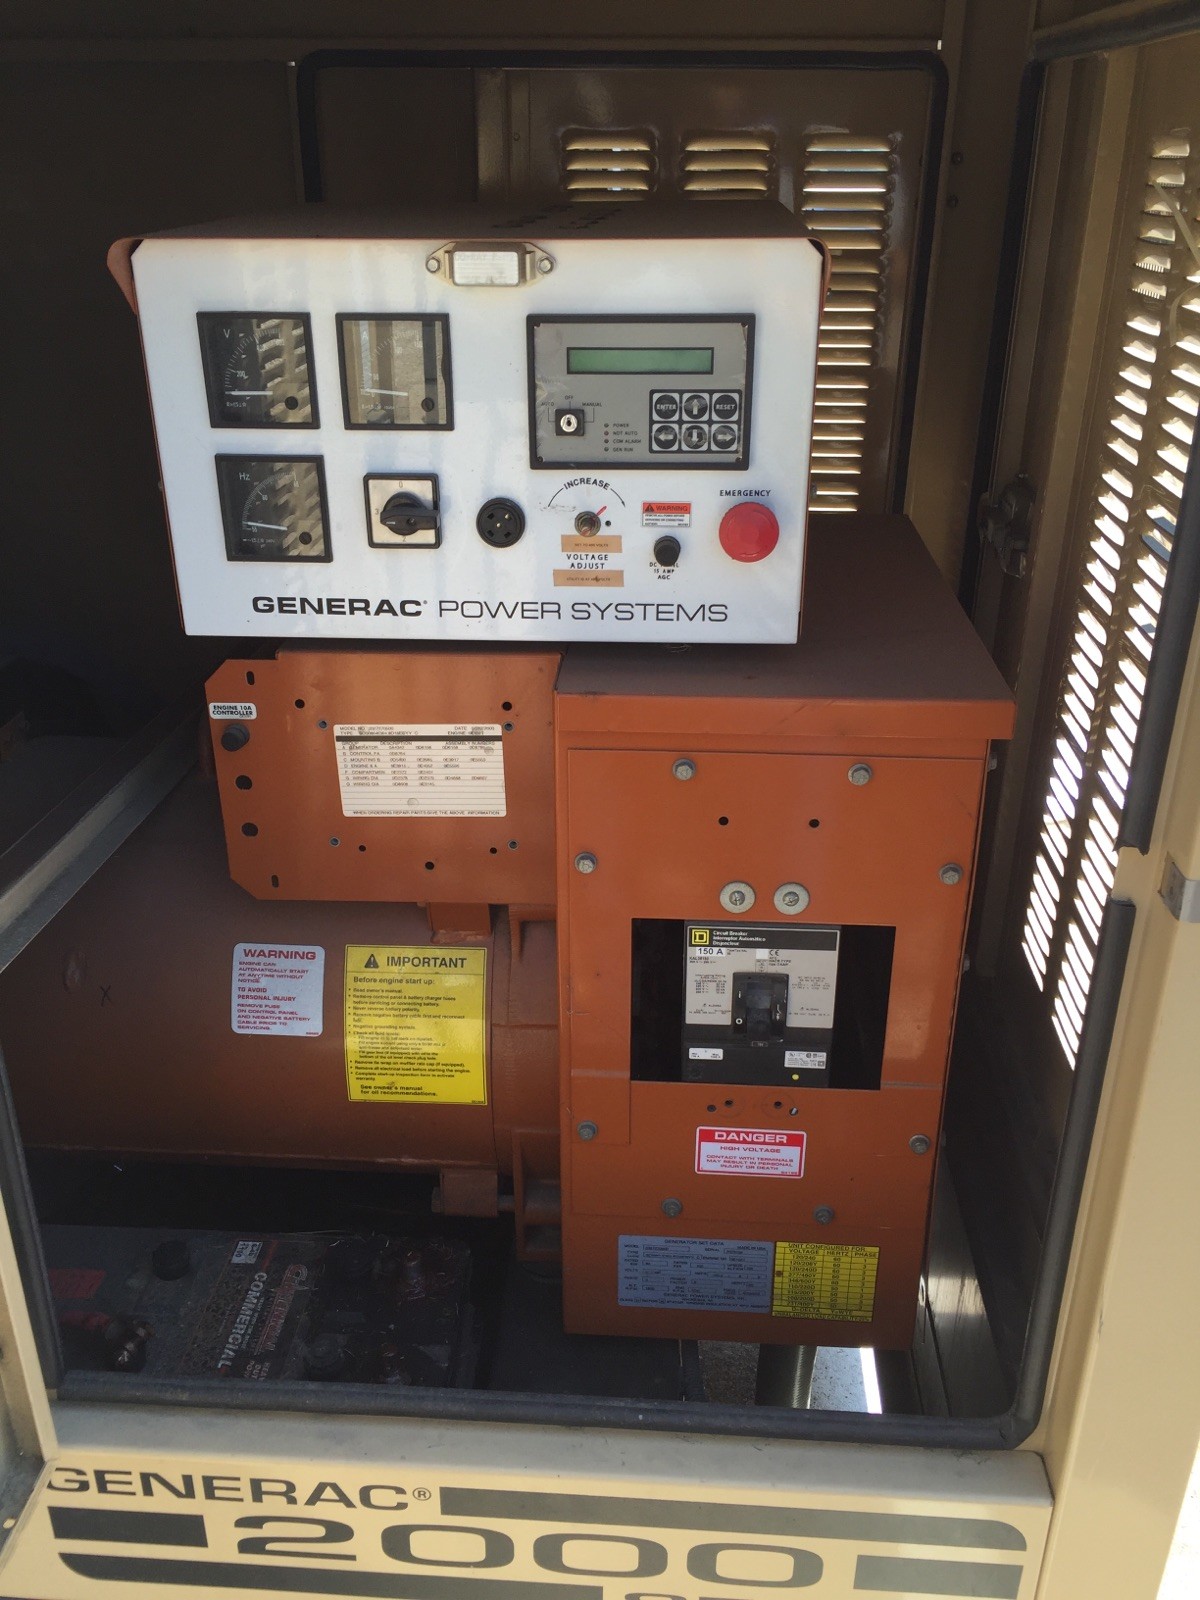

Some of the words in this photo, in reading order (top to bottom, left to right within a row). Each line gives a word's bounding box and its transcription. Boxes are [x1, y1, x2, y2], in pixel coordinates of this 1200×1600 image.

[564, 478, 610, 490] INCREASE
[440, 600, 561, 621] POWER
[571, 602, 729, 623] SYSTEMS
[243, 949, 316, 960] WARNING
[387, 956, 467, 968] IMPORTANT
[715, 1131, 787, 1143] DANGER
[217, 1272, 267, 1368] COMMERCIAL
[234, 1516, 824, 1588] 2000
